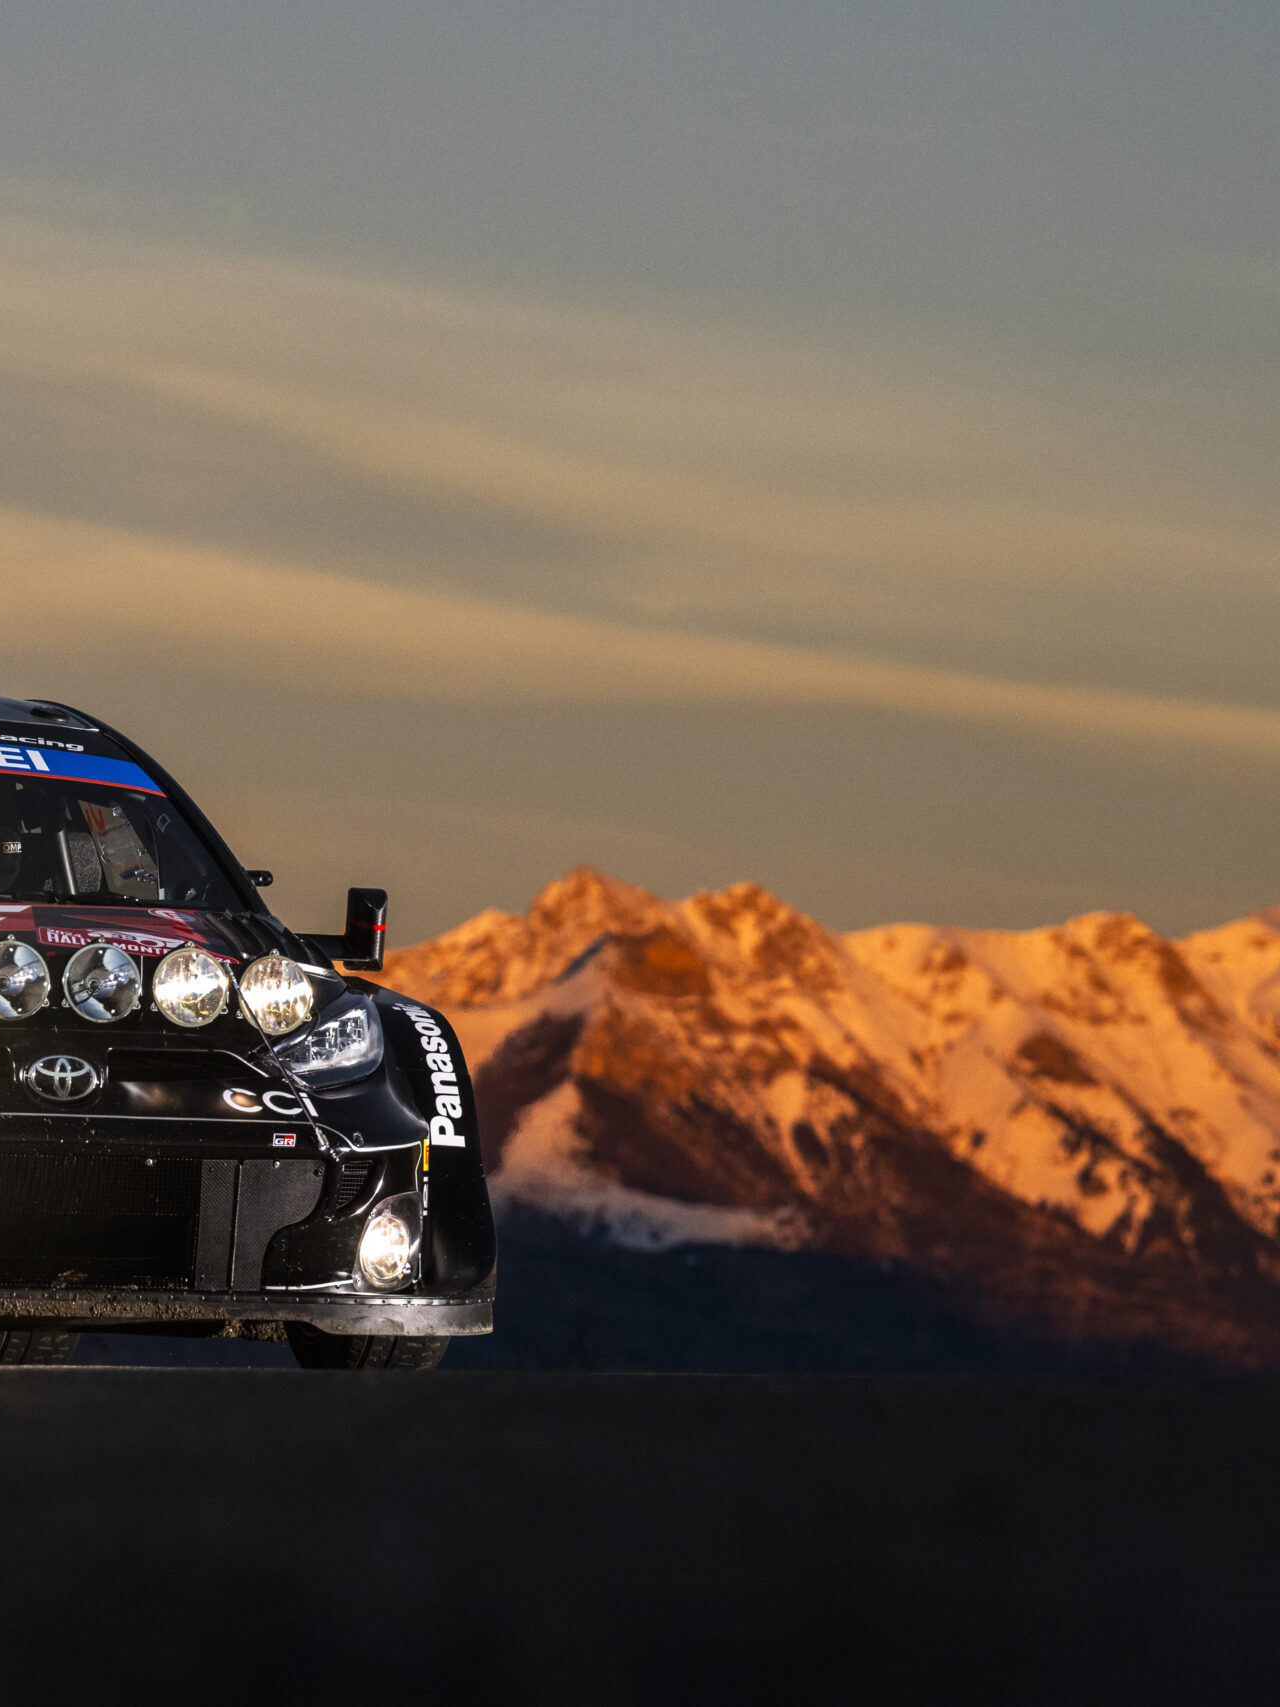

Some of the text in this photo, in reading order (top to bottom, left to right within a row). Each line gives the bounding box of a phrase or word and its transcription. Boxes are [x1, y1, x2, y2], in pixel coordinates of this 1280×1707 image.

[2, 842, 22, 852] OMP
[392, 1003, 465, 1147] Panasonic
[274, 1135, 295, 1146] GR
